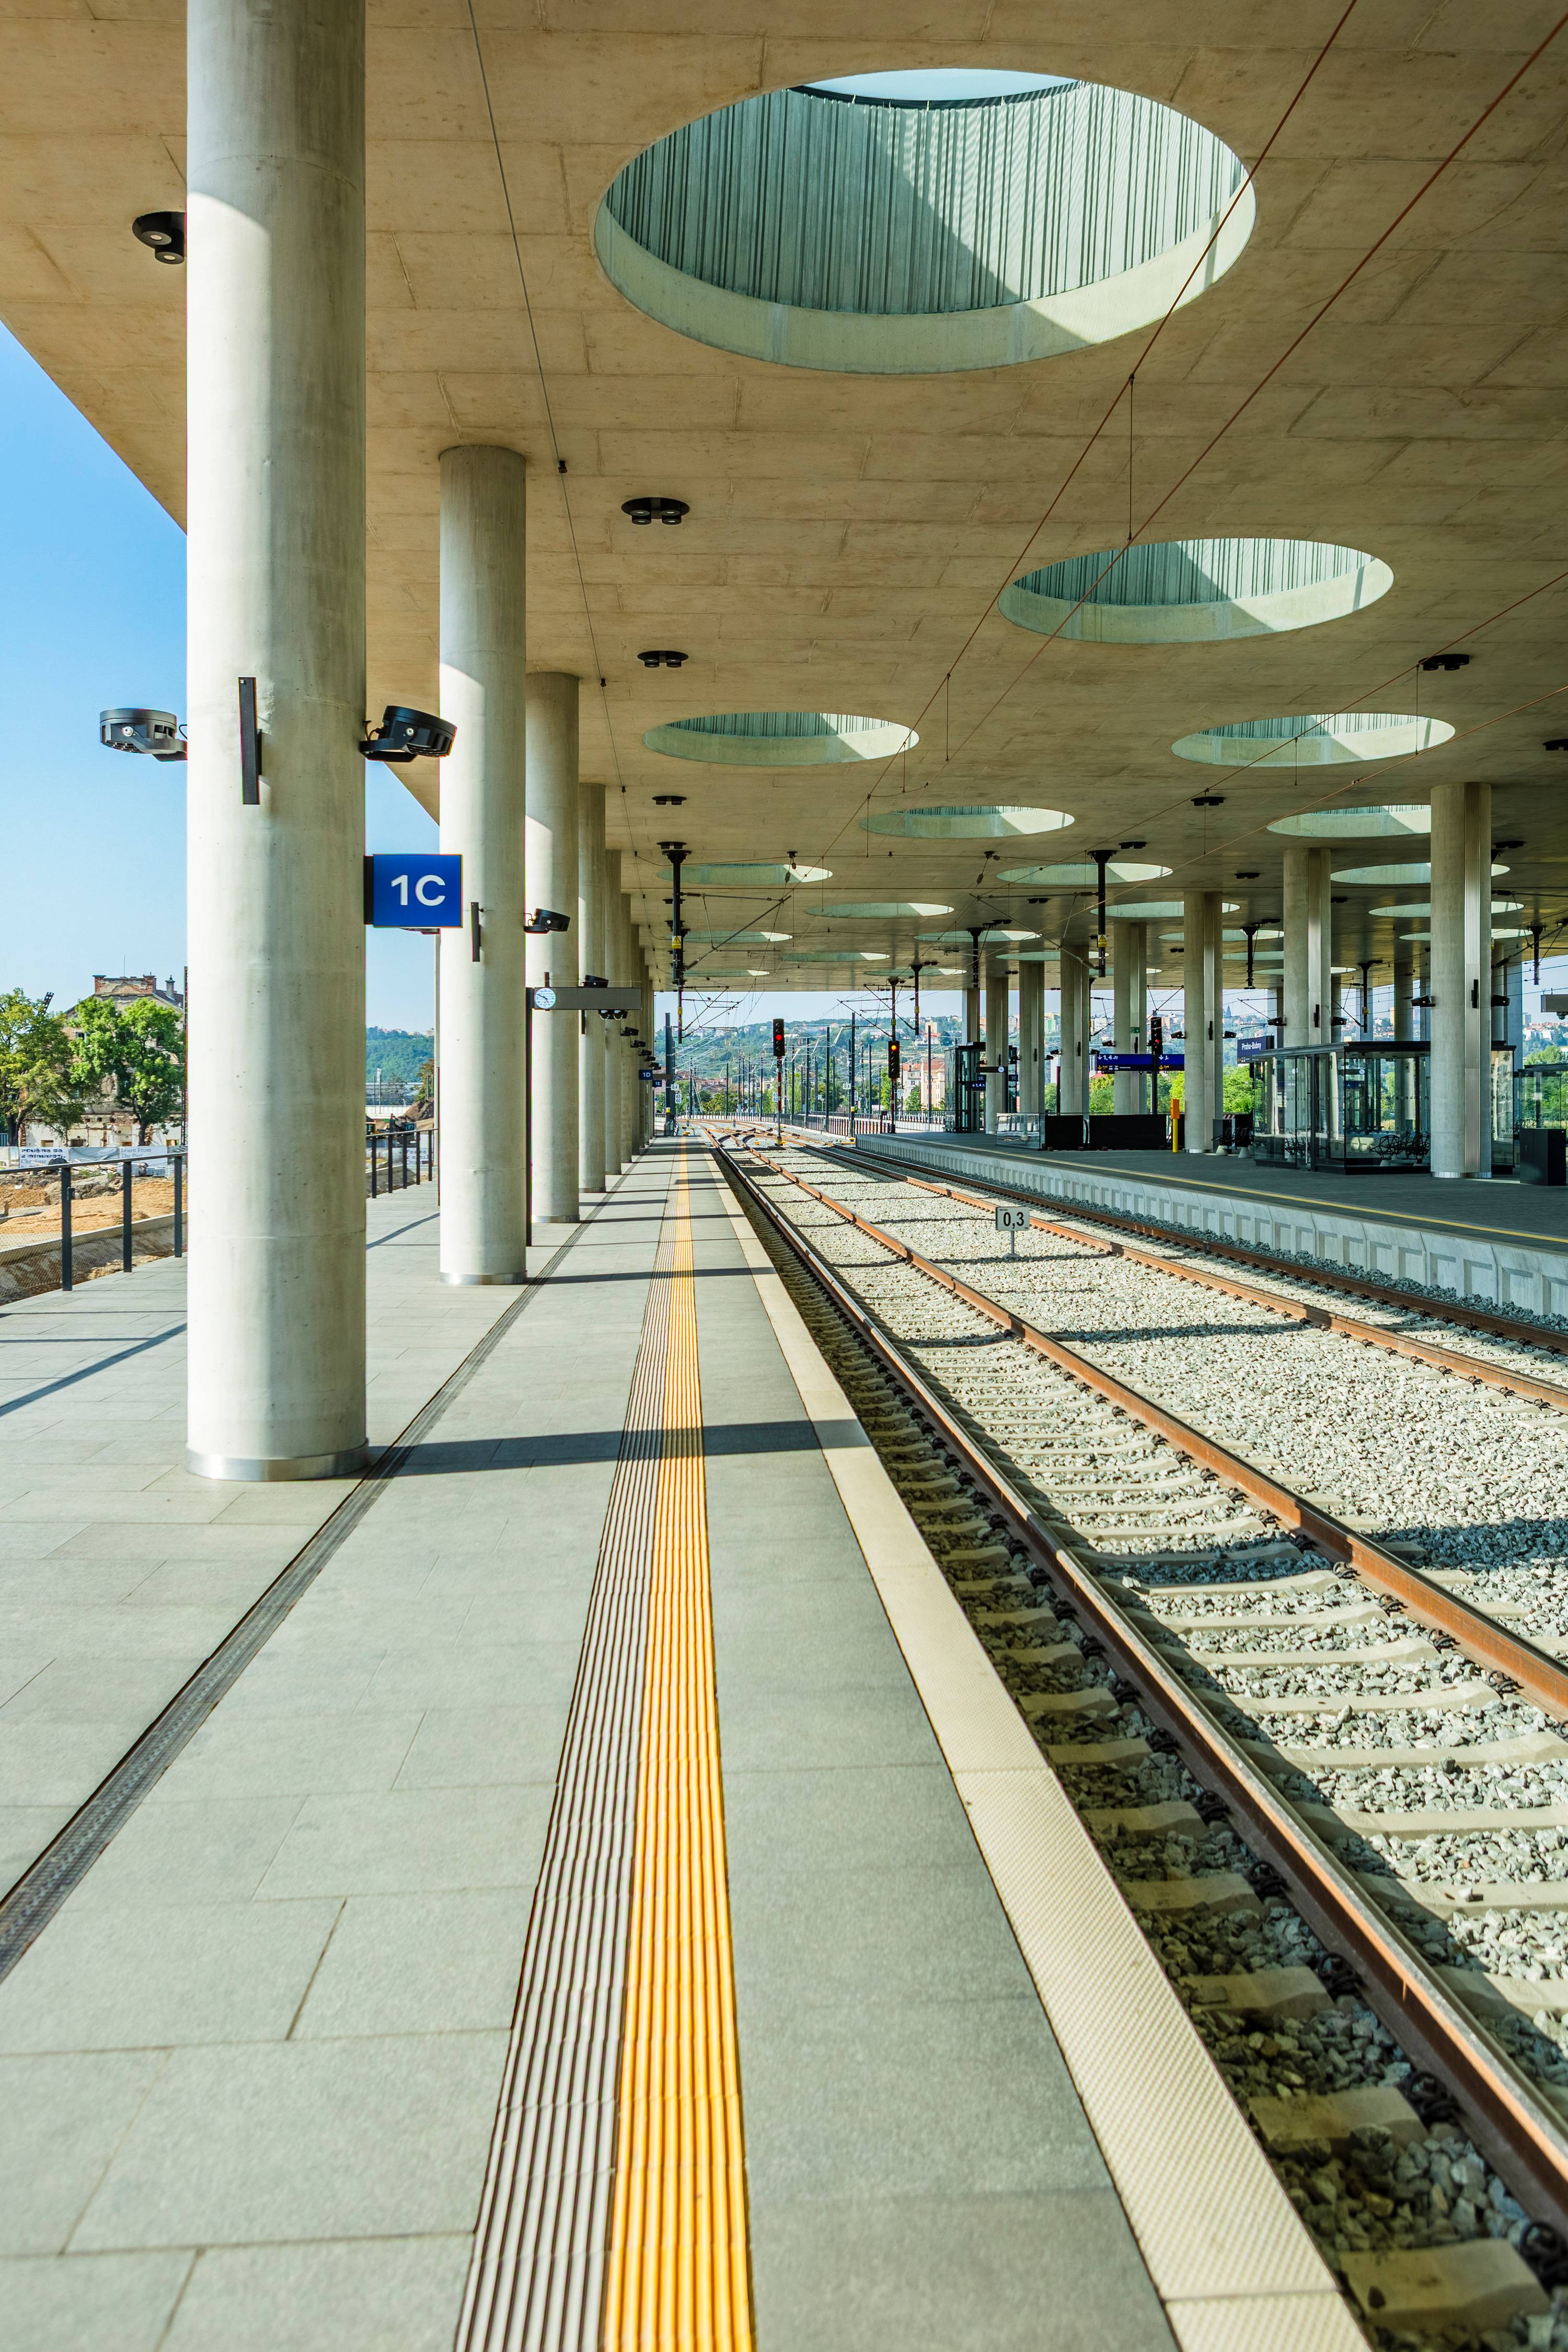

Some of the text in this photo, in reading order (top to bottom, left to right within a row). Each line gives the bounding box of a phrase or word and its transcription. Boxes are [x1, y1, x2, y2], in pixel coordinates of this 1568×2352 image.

[391, 874, 446, 906] 1C
[1241, 1041, 1262, 1051] Praha-Bubny
[1004, 1212, 1024, 1229] 0,3
